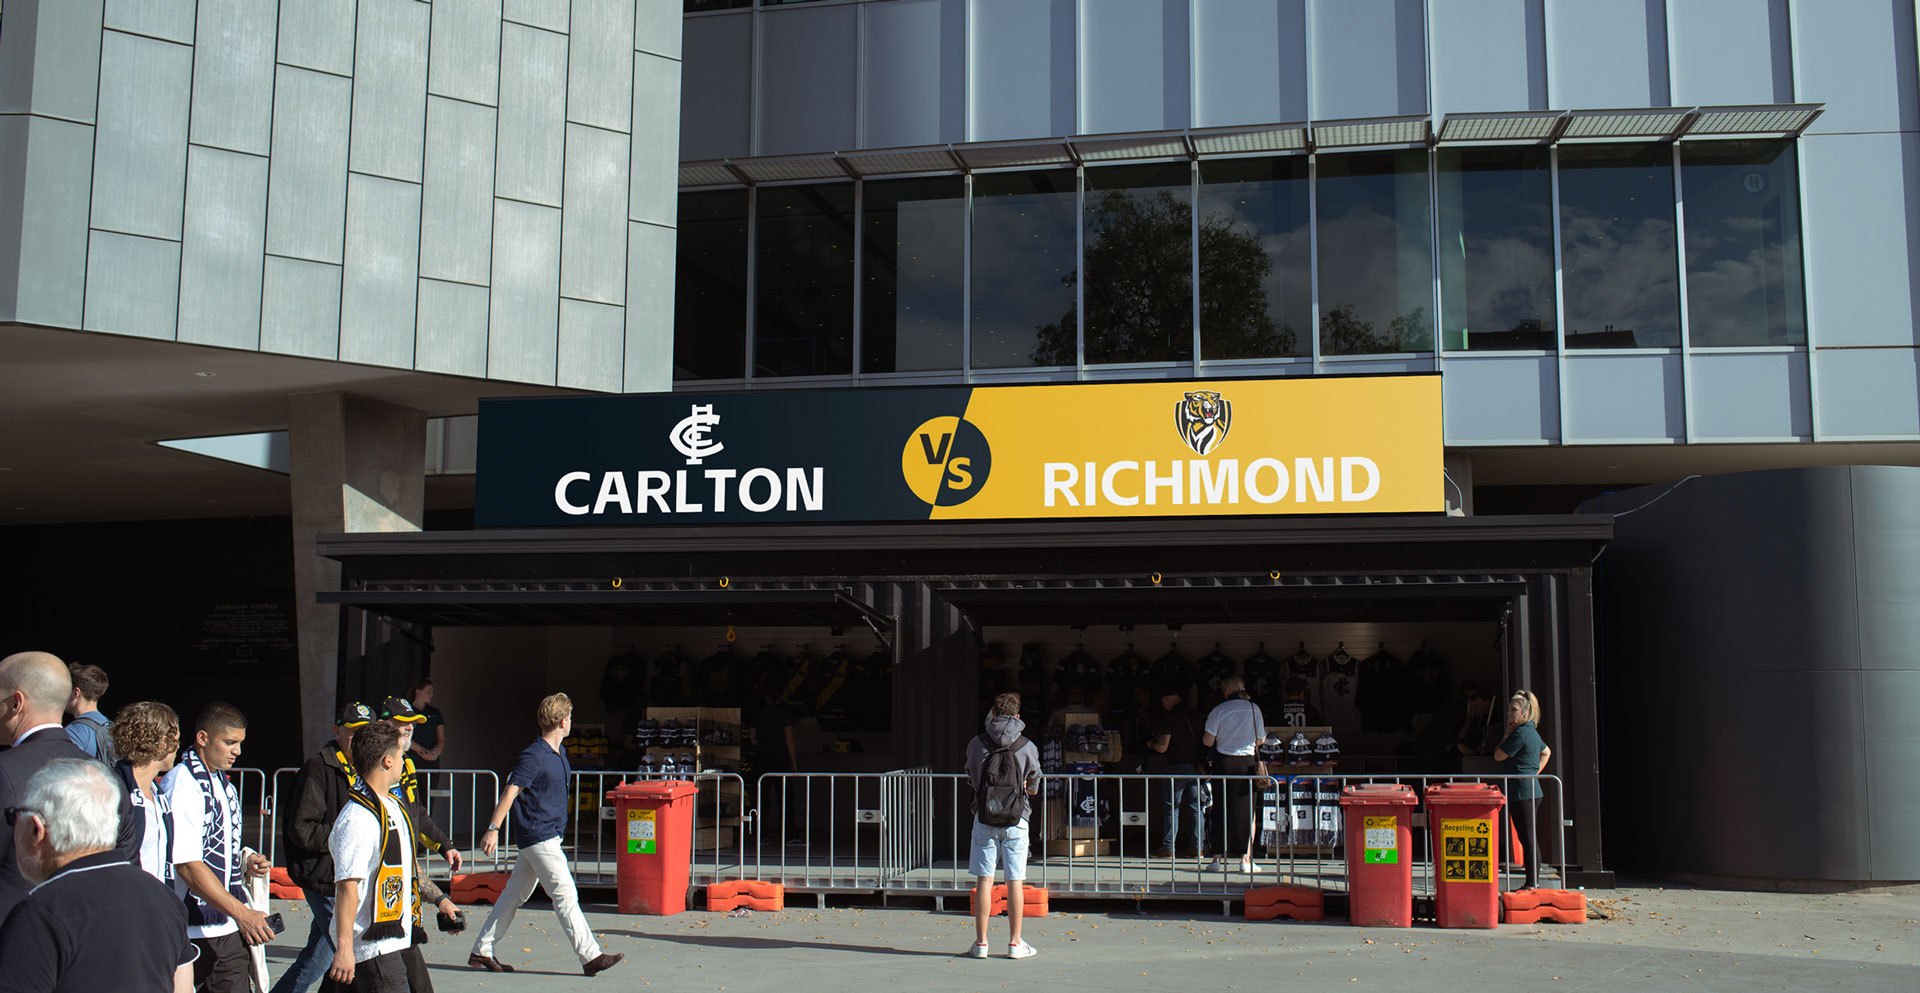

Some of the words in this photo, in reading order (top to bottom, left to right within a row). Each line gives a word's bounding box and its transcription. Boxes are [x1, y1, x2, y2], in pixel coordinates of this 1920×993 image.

[919, 432, 973, 490] VS
[1044, 456, 1381, 507] RICHMOND
[555, 467, 824, 516] CARLTON
[1283, 712, 1306, 727] 30
[1442, 824, 1475, 832] Recycling
